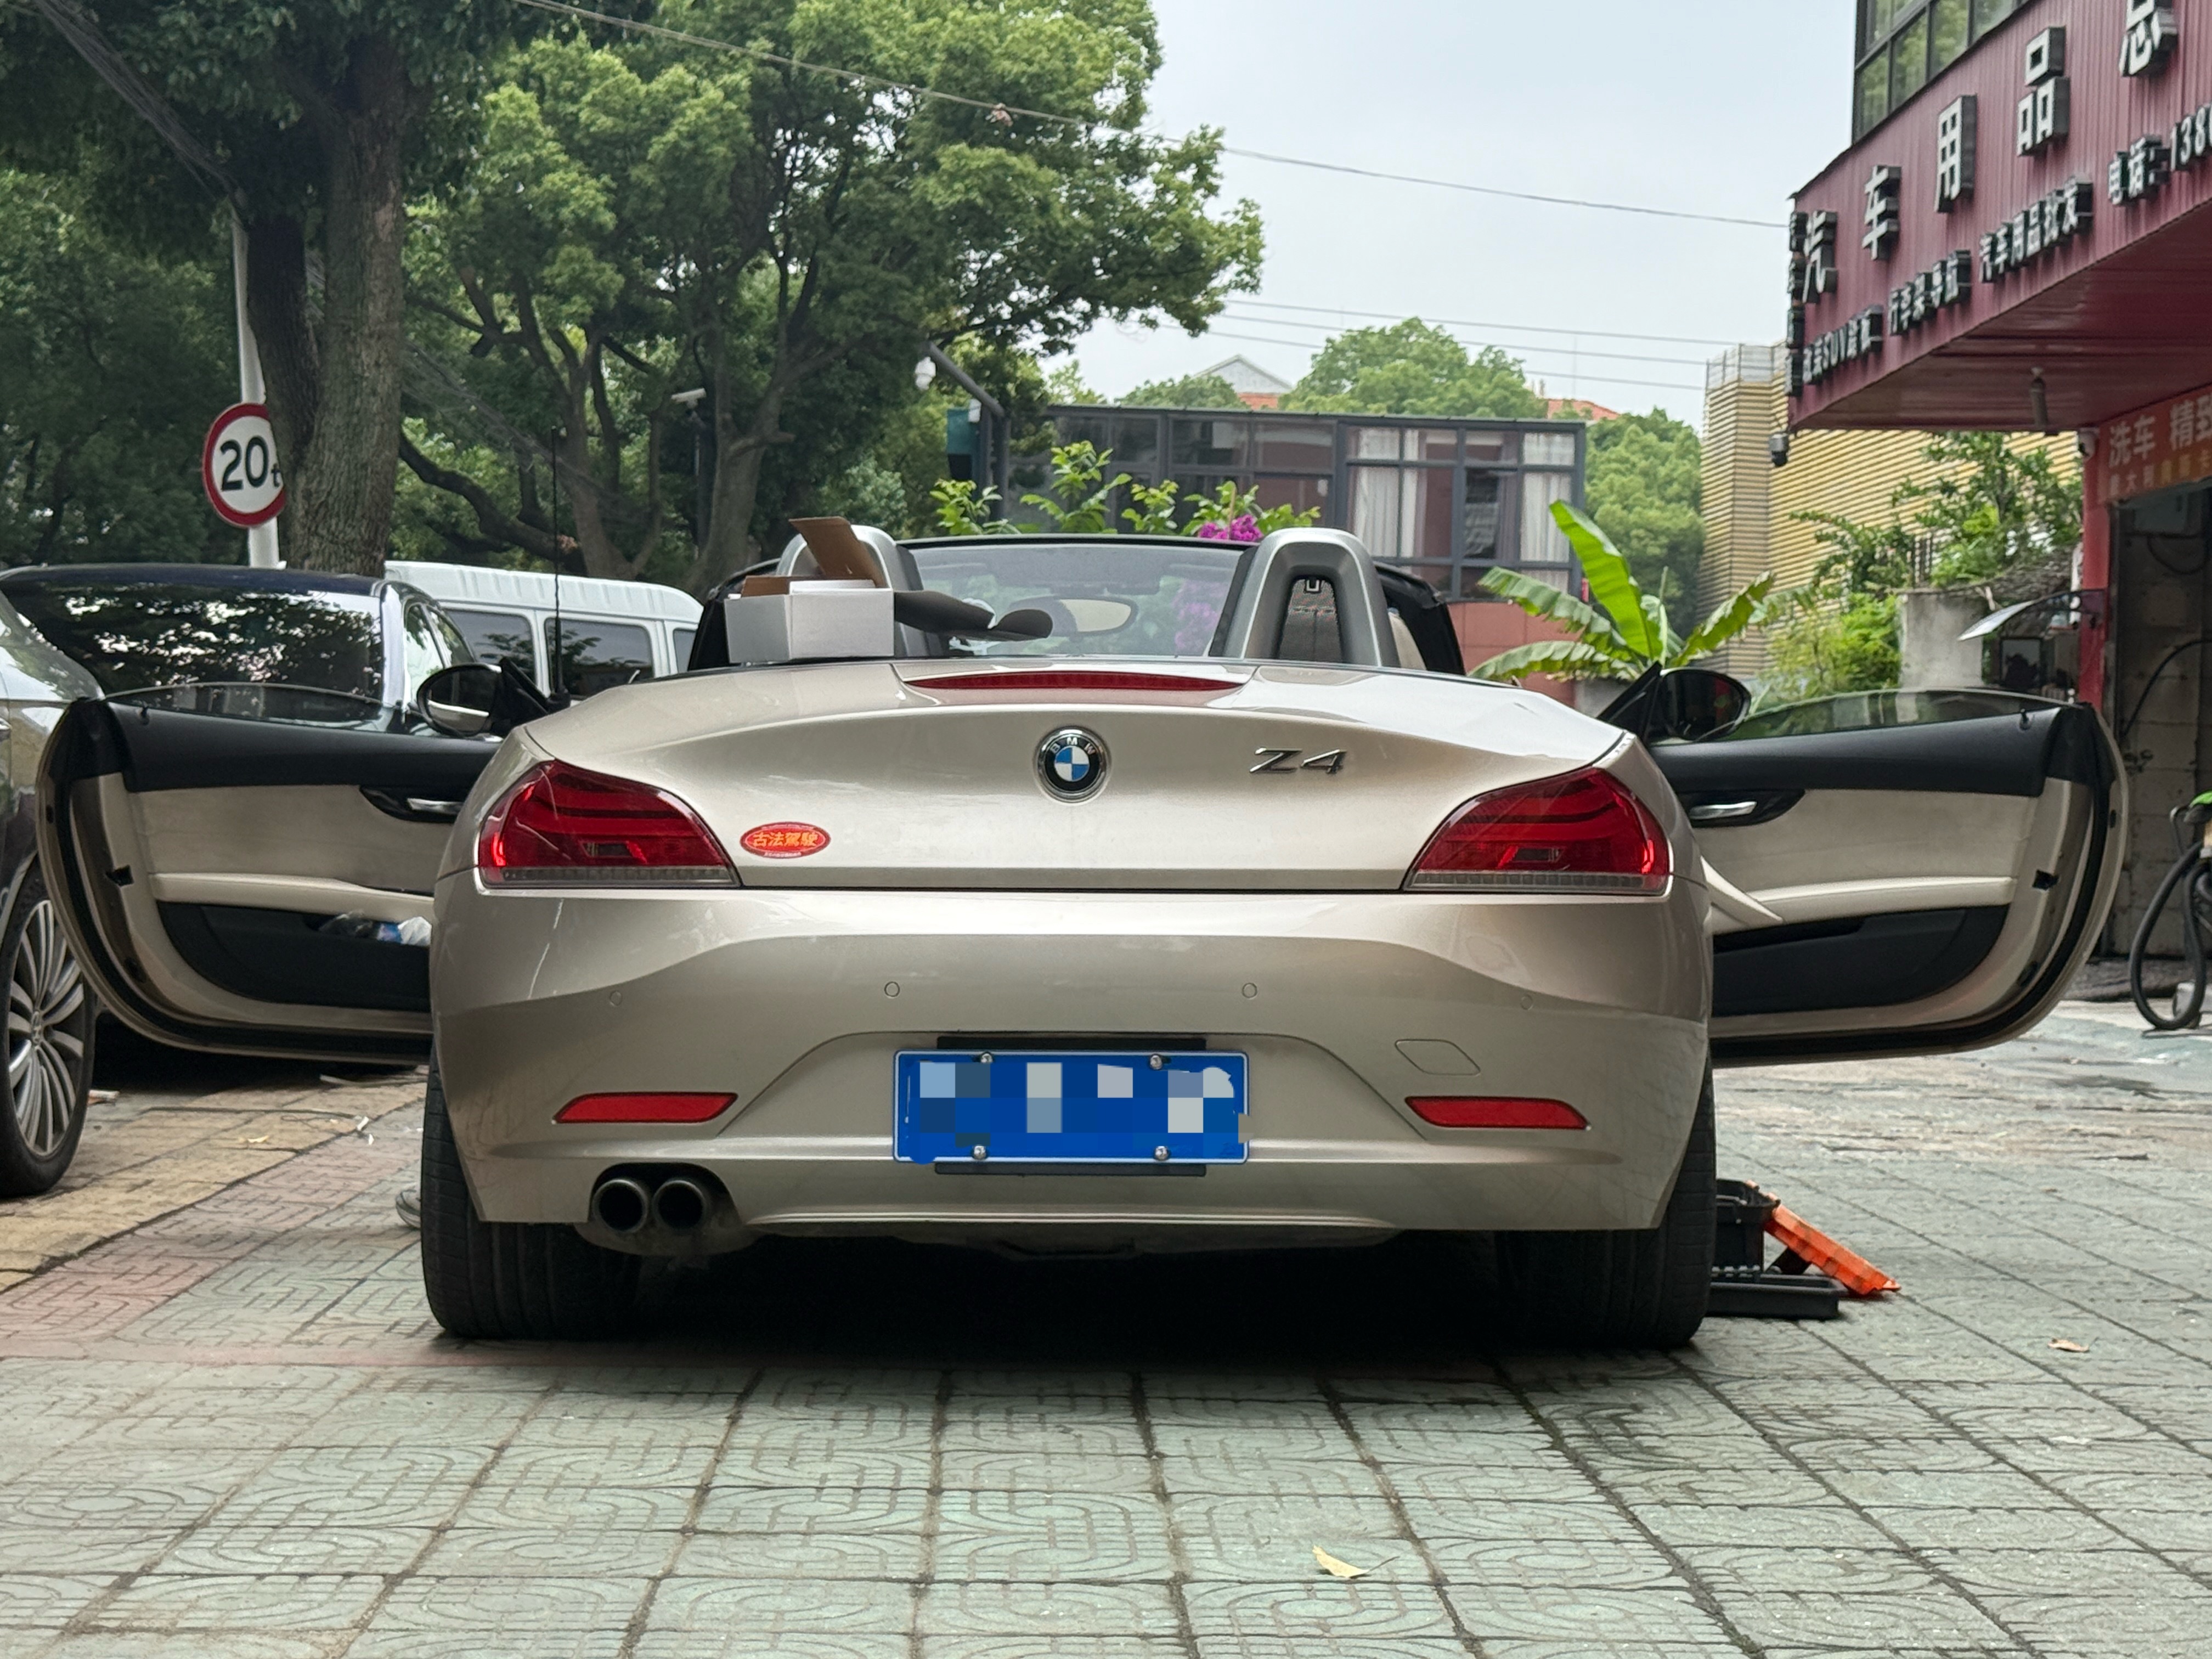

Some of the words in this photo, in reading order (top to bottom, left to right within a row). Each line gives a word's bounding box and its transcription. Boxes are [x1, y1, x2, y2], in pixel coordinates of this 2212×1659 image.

[2109, 414, 2156, 467] 洗车
[1050, 737, 1096, 755] BMW
[1249, 747, 1347, 774] Z4
